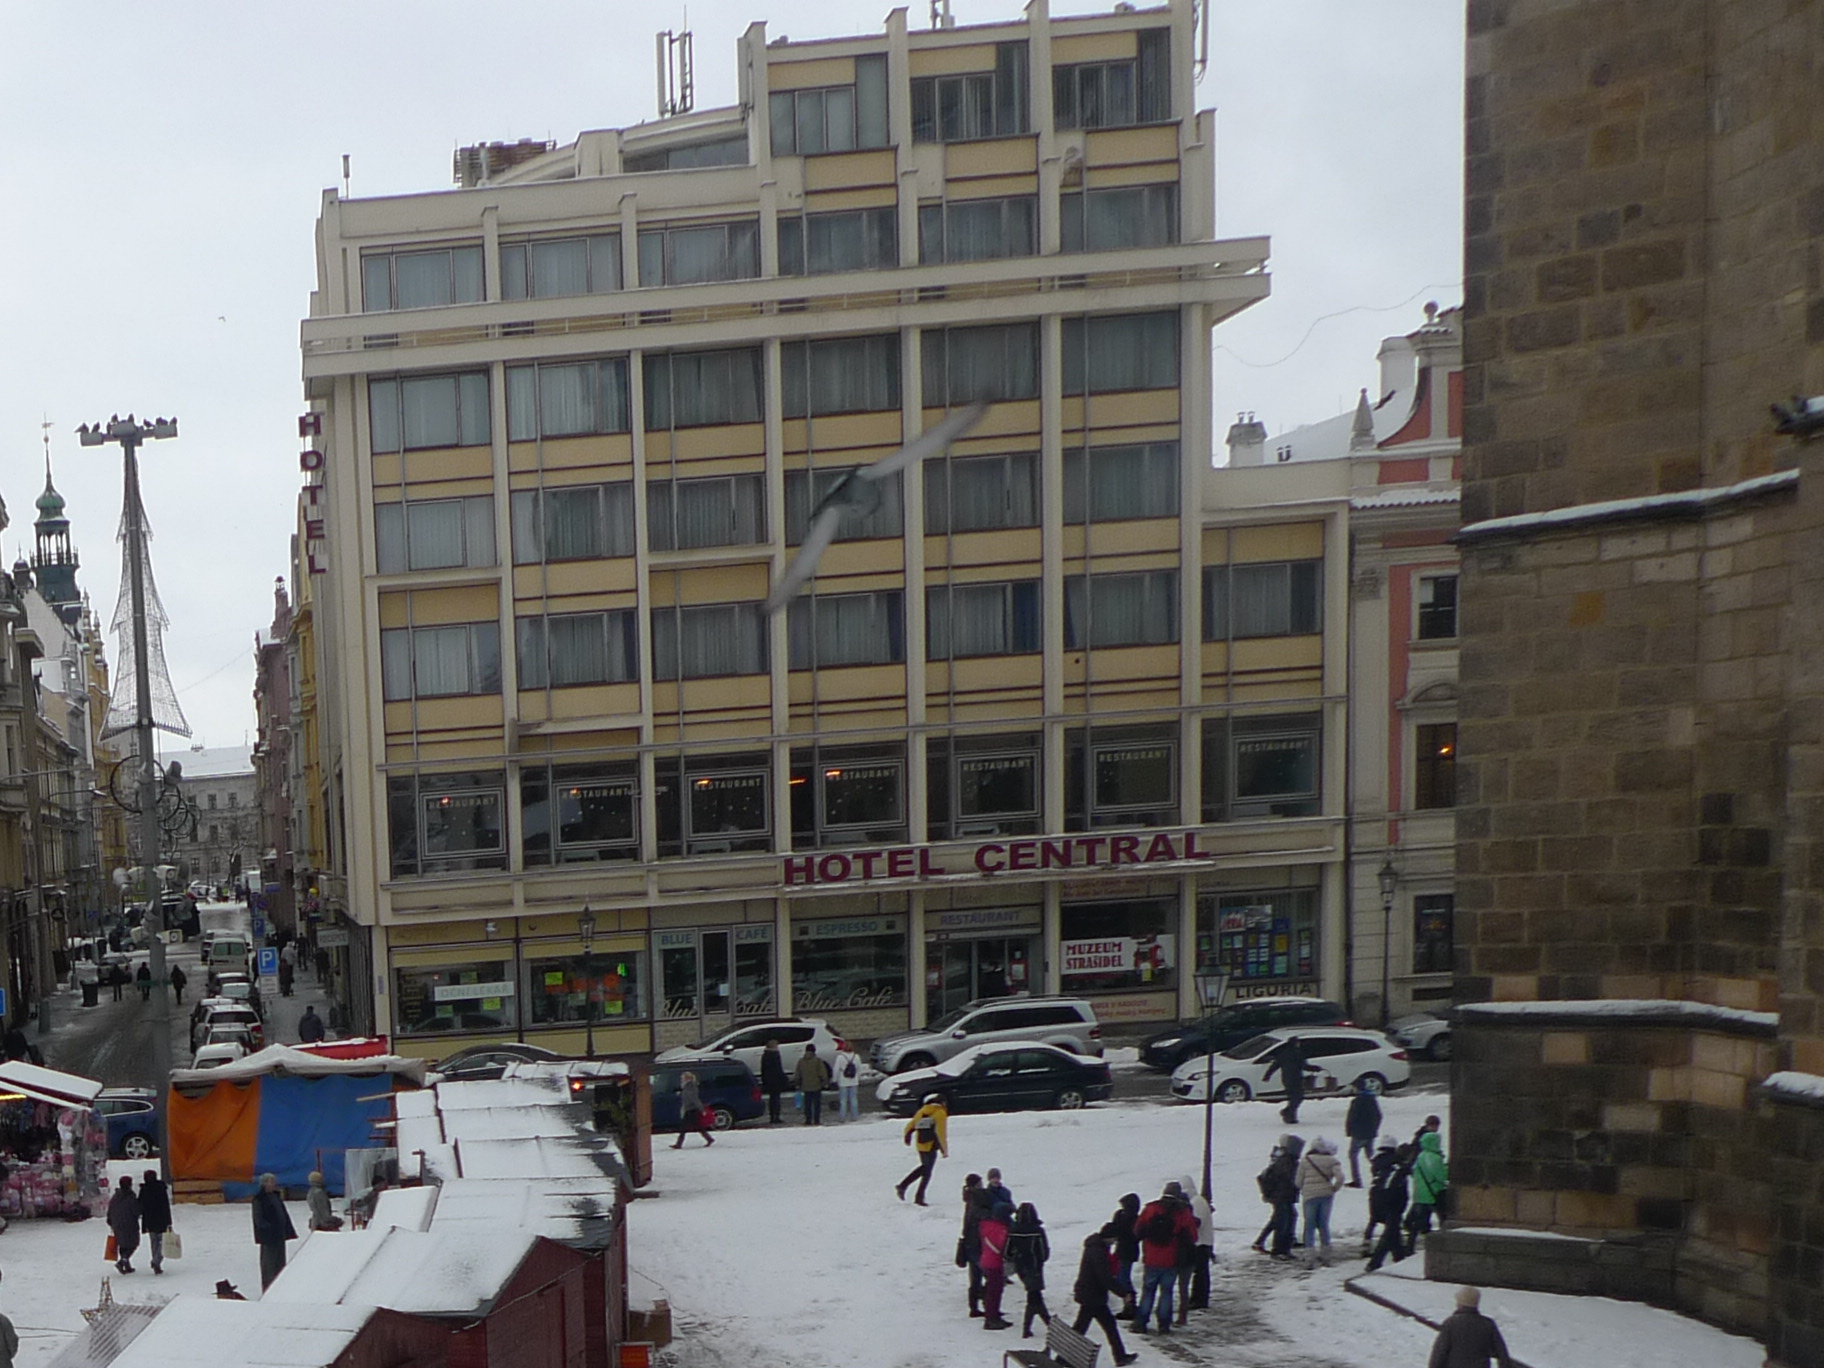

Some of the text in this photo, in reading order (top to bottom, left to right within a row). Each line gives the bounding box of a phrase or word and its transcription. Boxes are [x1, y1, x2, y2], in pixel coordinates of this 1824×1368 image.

[1098, 750, 1167, 762] RESTAURANT
[963, 760, 1031, 771] RESTAURANT
[783, 832, 1211, 886] HOTEL CENTRAL
[940, 910, 1021, 926] RESTAURANT
[816, 920, 878, 935] ESPRESSO
[661, 927, 768, 946] BLUE CAFÉ
[1066, 941, 1122, 956] MUZEUM
[261, 951, 273, 967] P
[1066, 954, 1123, 970] STRAŠIDEL
[794, 985, 895, 1010] Blue Café
[1235, 982, 1312, 999] LIGURIA
